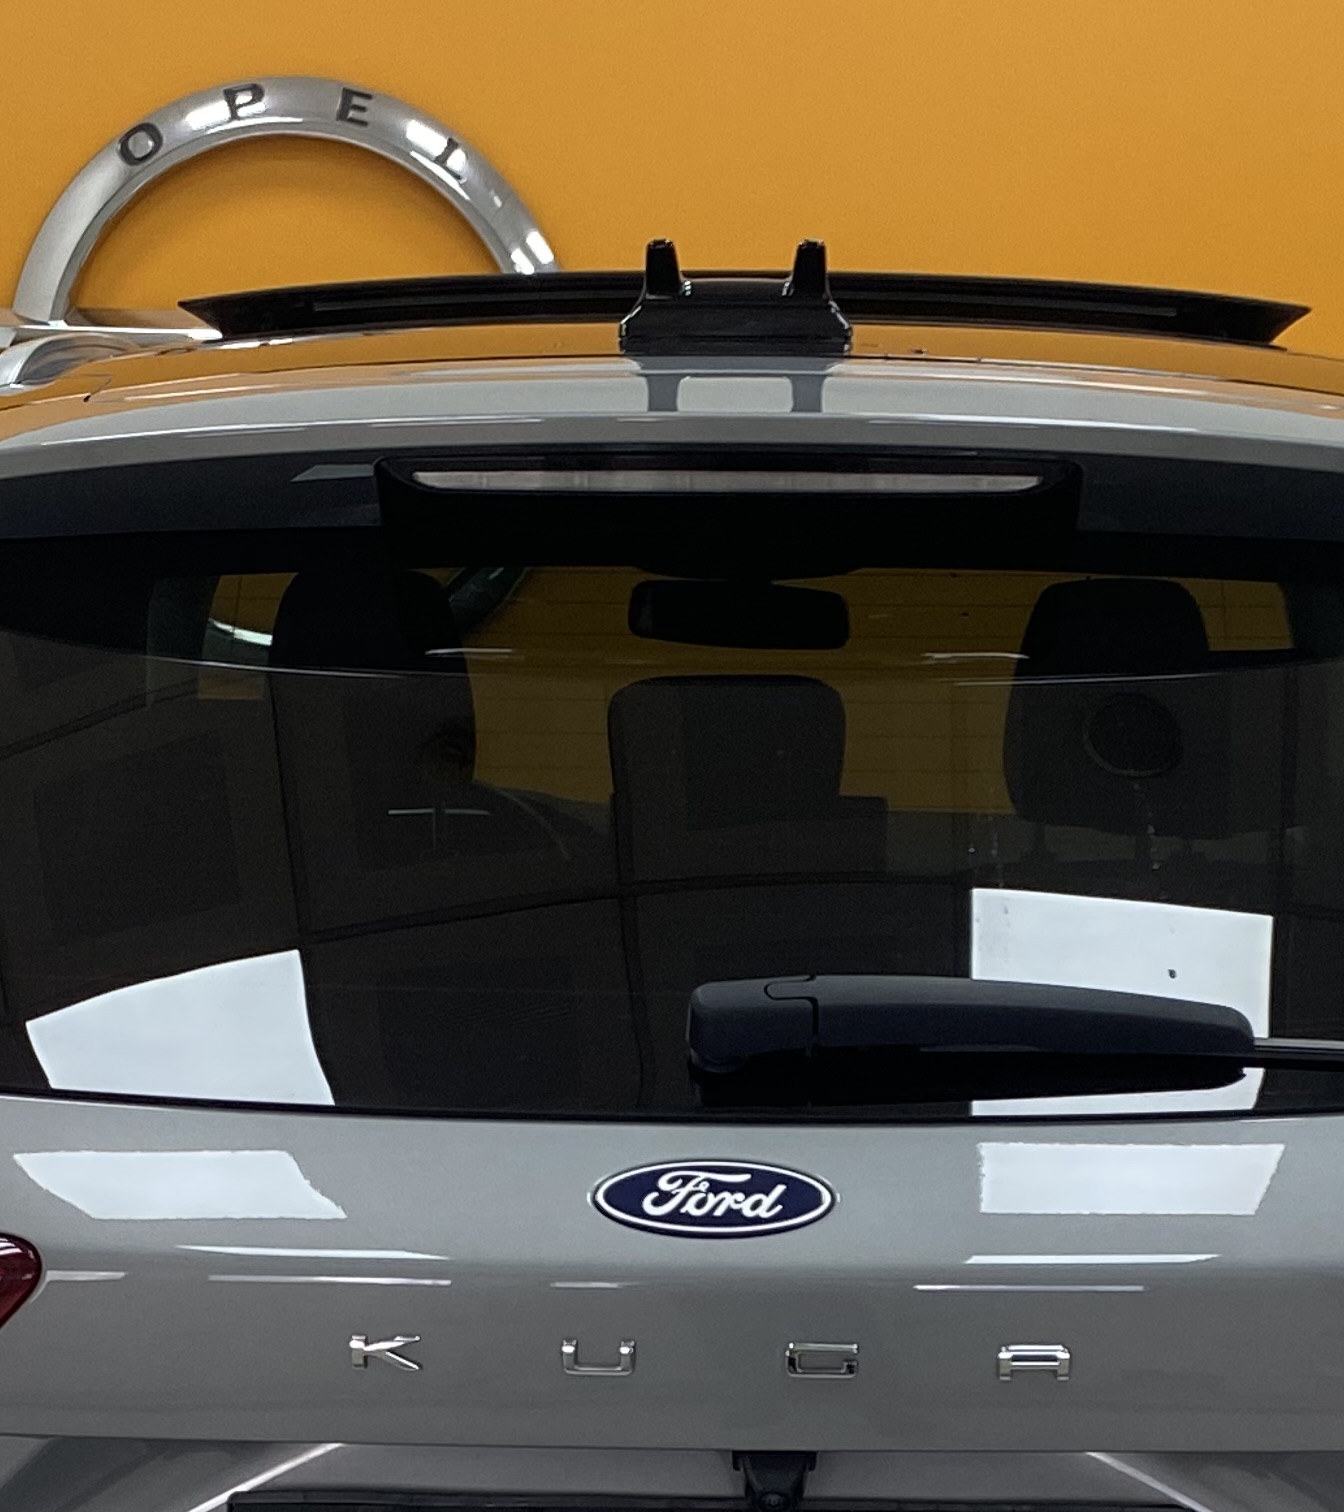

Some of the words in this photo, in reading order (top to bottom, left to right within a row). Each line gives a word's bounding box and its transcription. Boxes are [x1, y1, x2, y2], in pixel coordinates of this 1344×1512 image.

[118, 82, 467, 182] OPEL
[642, 1169, 787, 1222] Ford
[349, 1334, 1072, 1381] KUGA
